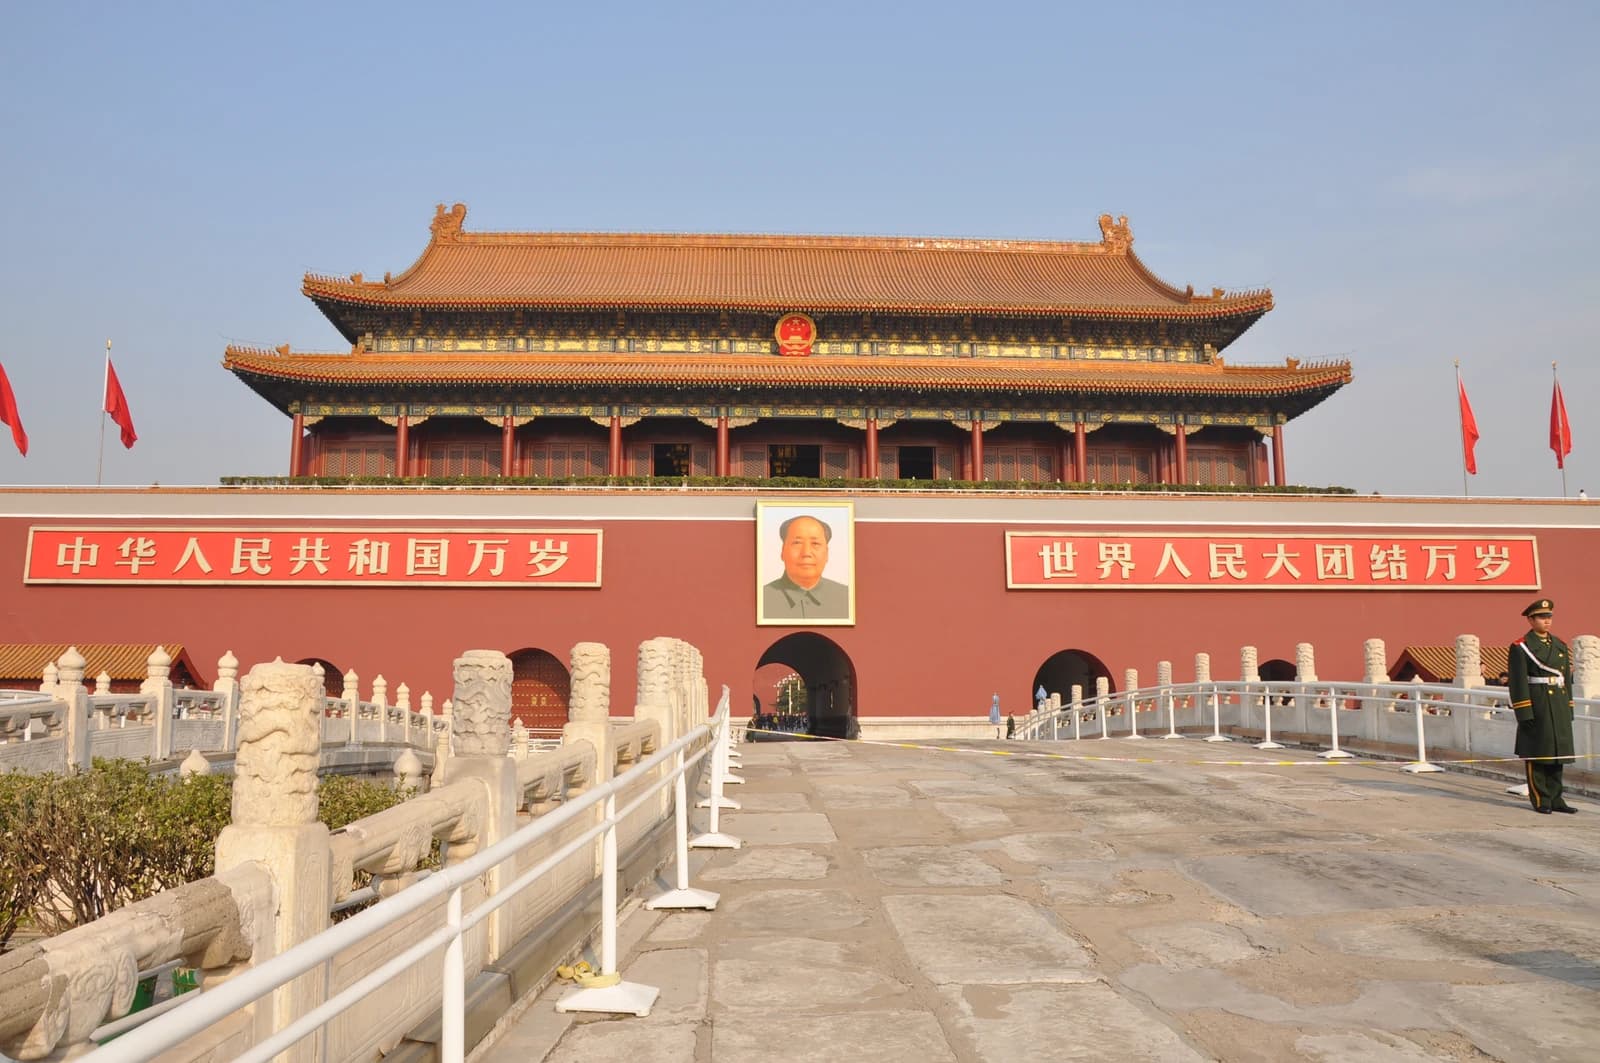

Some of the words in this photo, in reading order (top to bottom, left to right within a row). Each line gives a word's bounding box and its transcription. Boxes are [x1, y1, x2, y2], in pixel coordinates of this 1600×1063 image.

[56, 536, 570, 577] 中华人民共和国万岁
[1038, 541, 1511, 581] 世界人民大团结万岁
